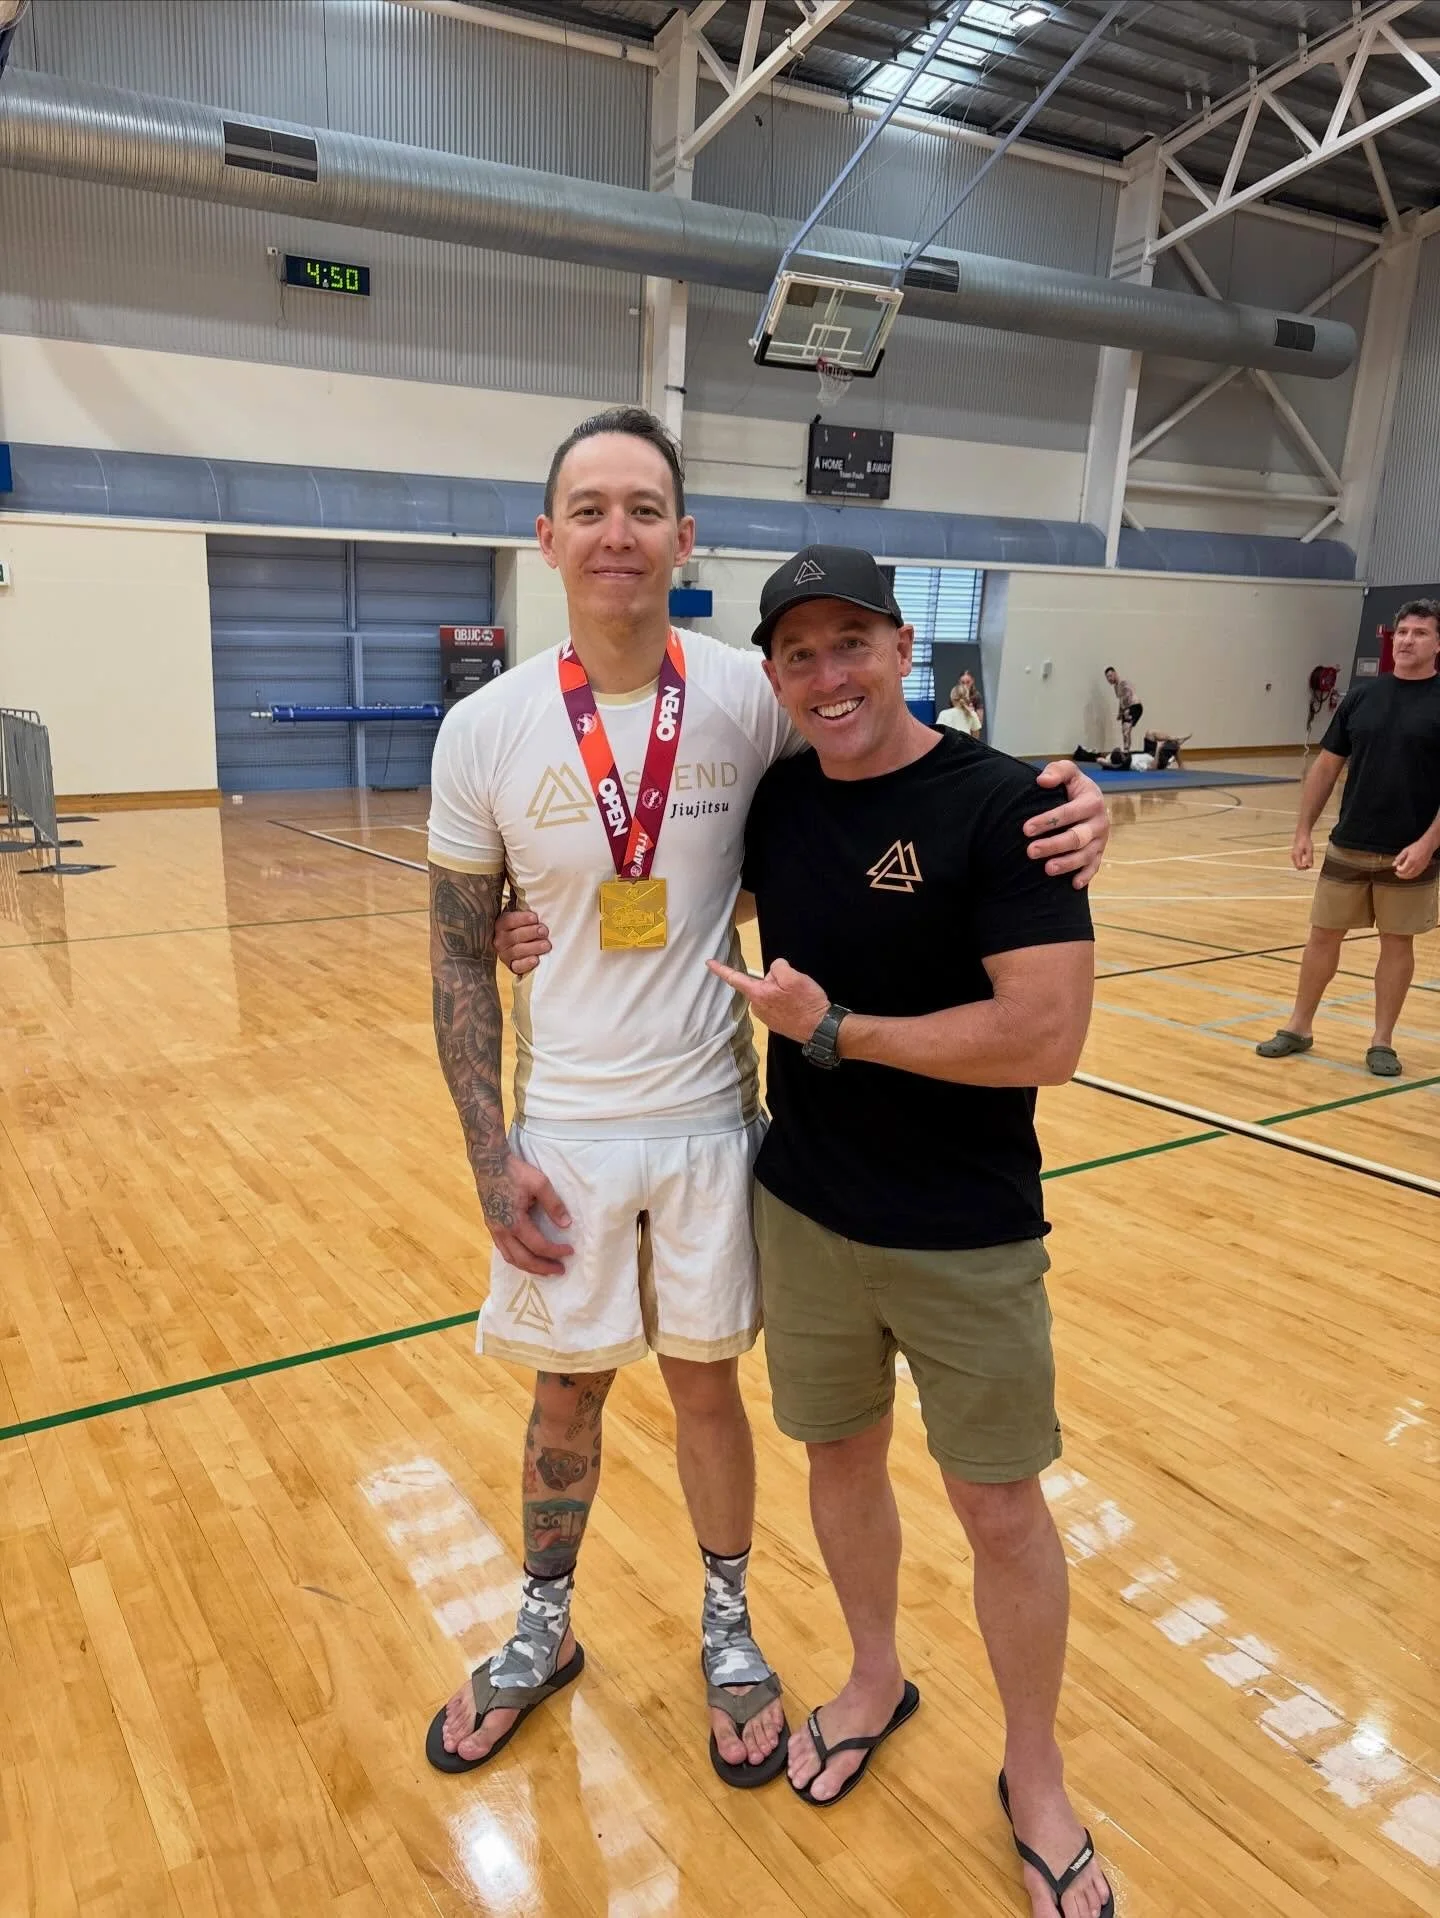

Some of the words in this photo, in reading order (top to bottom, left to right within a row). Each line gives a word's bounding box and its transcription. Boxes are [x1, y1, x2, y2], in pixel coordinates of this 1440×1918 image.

[307, 262, 358, 290] 4:50
[814, 456, 820, 469] A
[821, 458, 843, 471] HOME
[872, 463, 891, 473] AWAY
[656, 685, 681, 741] OPEN
[598, 777, 629, 837] OPEN
[670, 801, 729, 819] Jiujitsu
